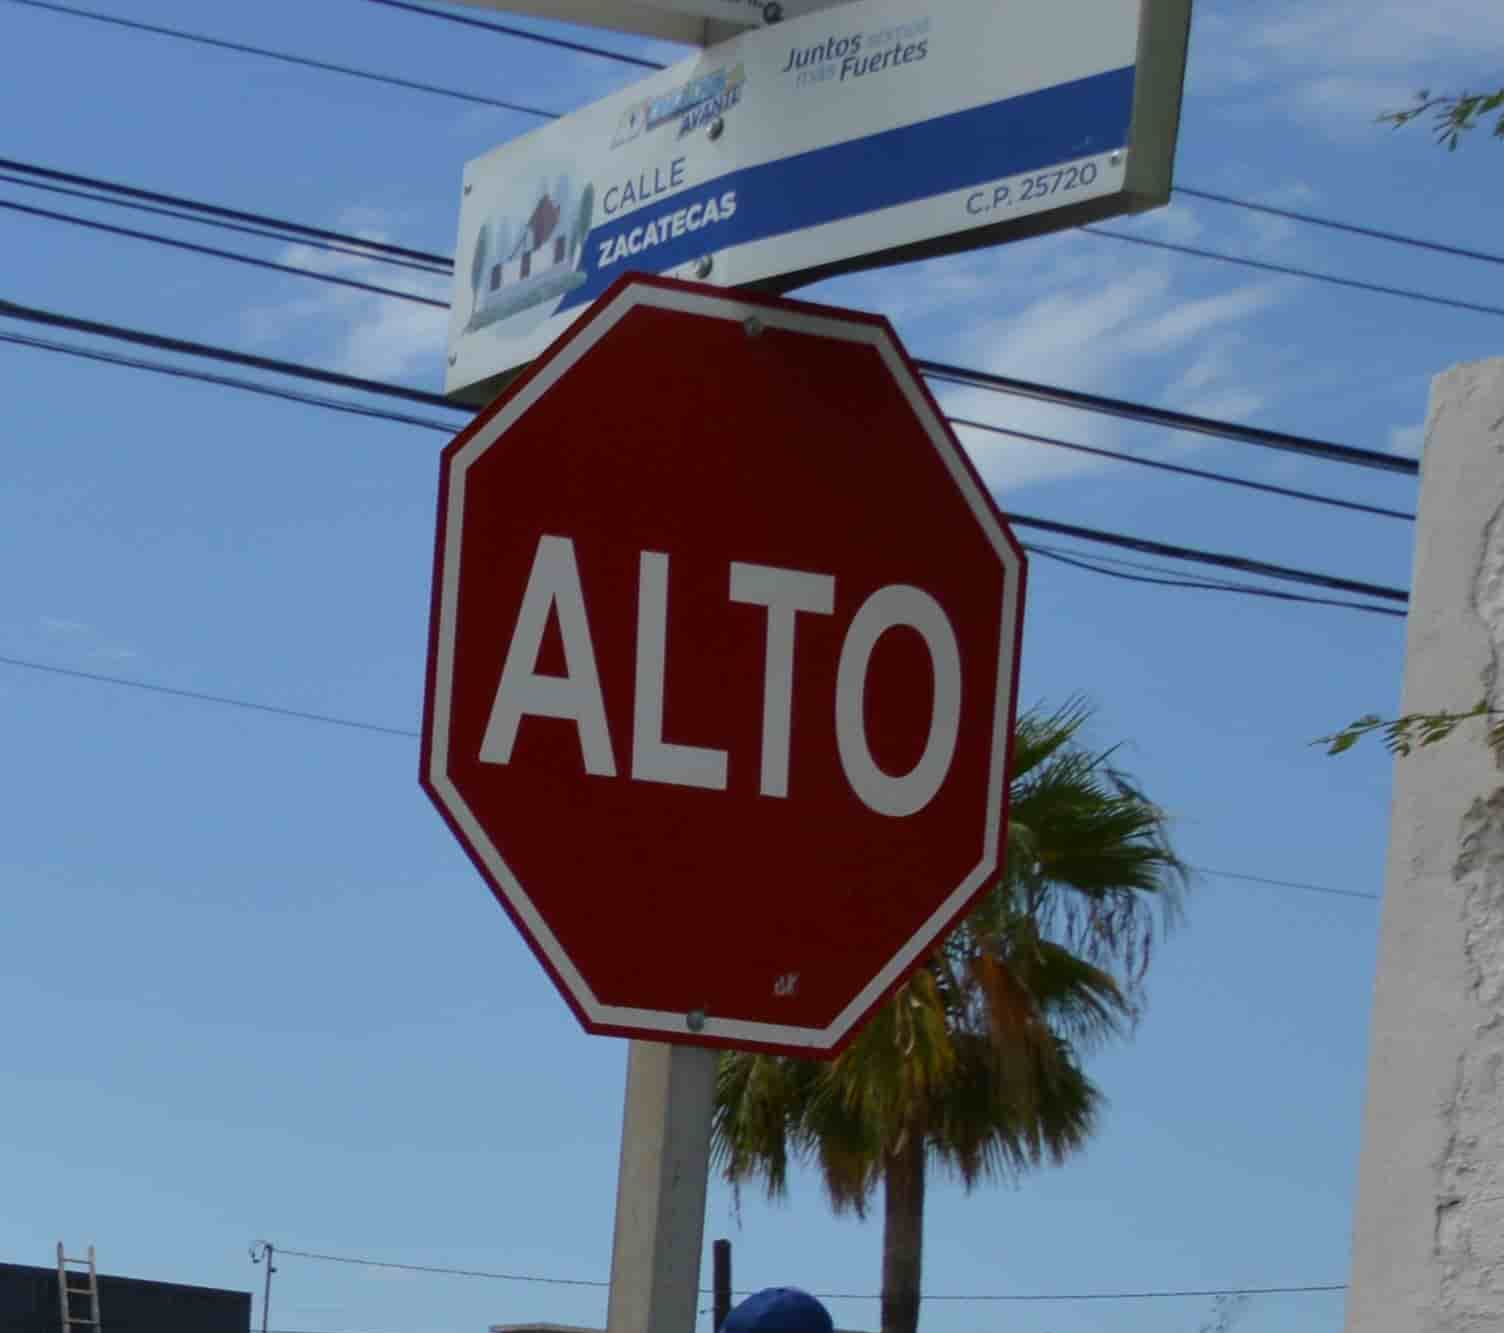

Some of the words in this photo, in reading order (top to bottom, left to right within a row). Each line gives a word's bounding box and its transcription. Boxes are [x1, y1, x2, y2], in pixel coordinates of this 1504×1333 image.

[782, 34, 863, 73] Juntos
[839, 40, 929, 83] Fuertes
[603, 157, 686, 215] CALLE
[965, 187, 1013, 215] C.P.
[1019, 163, 1097, 201] 25720
[597, 191, 737, 269] ZACATECAS
[478, 533, 962, 817] ALTO
